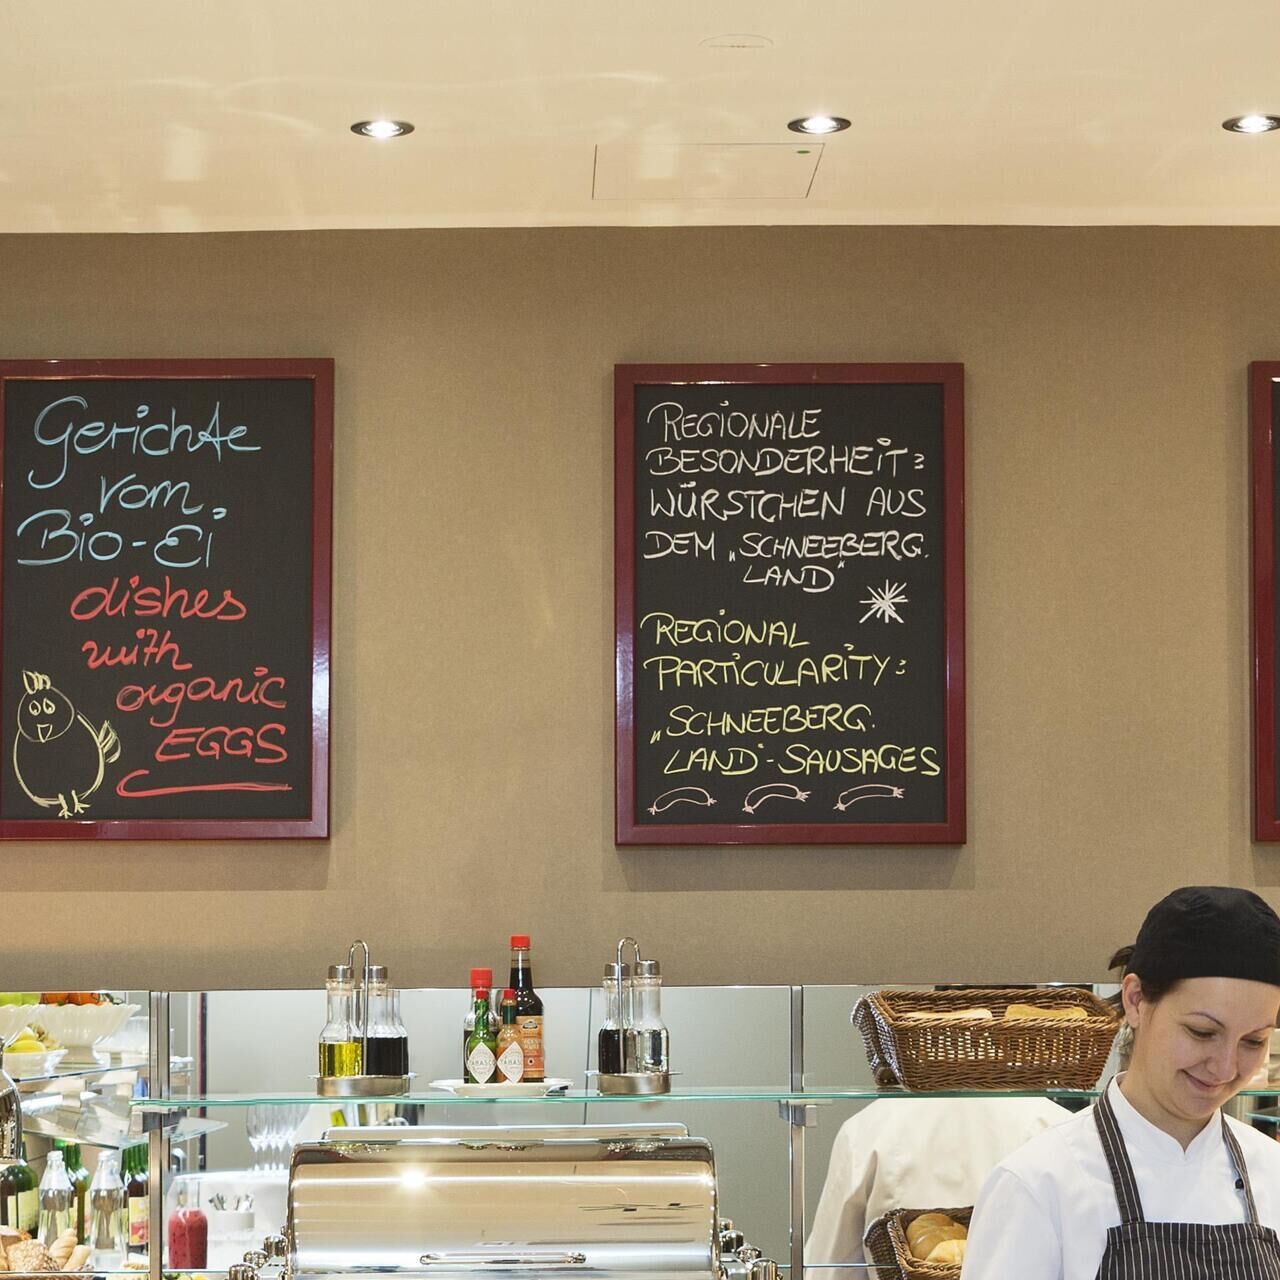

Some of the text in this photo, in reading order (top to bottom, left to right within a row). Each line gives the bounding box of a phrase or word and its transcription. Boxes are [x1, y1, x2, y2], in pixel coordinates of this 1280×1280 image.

[28, 395, 261, 489] Gerichte
[650, 481, 926, 523] WÜRSTCHEN AUS
[643, 530, 715, 562] DEM
[71, 575, 247, 621] dishes
[82, 629, 192, 670] with
[117, 667, 287, 726] organic
[155, 724, 288, 763] EGGS
